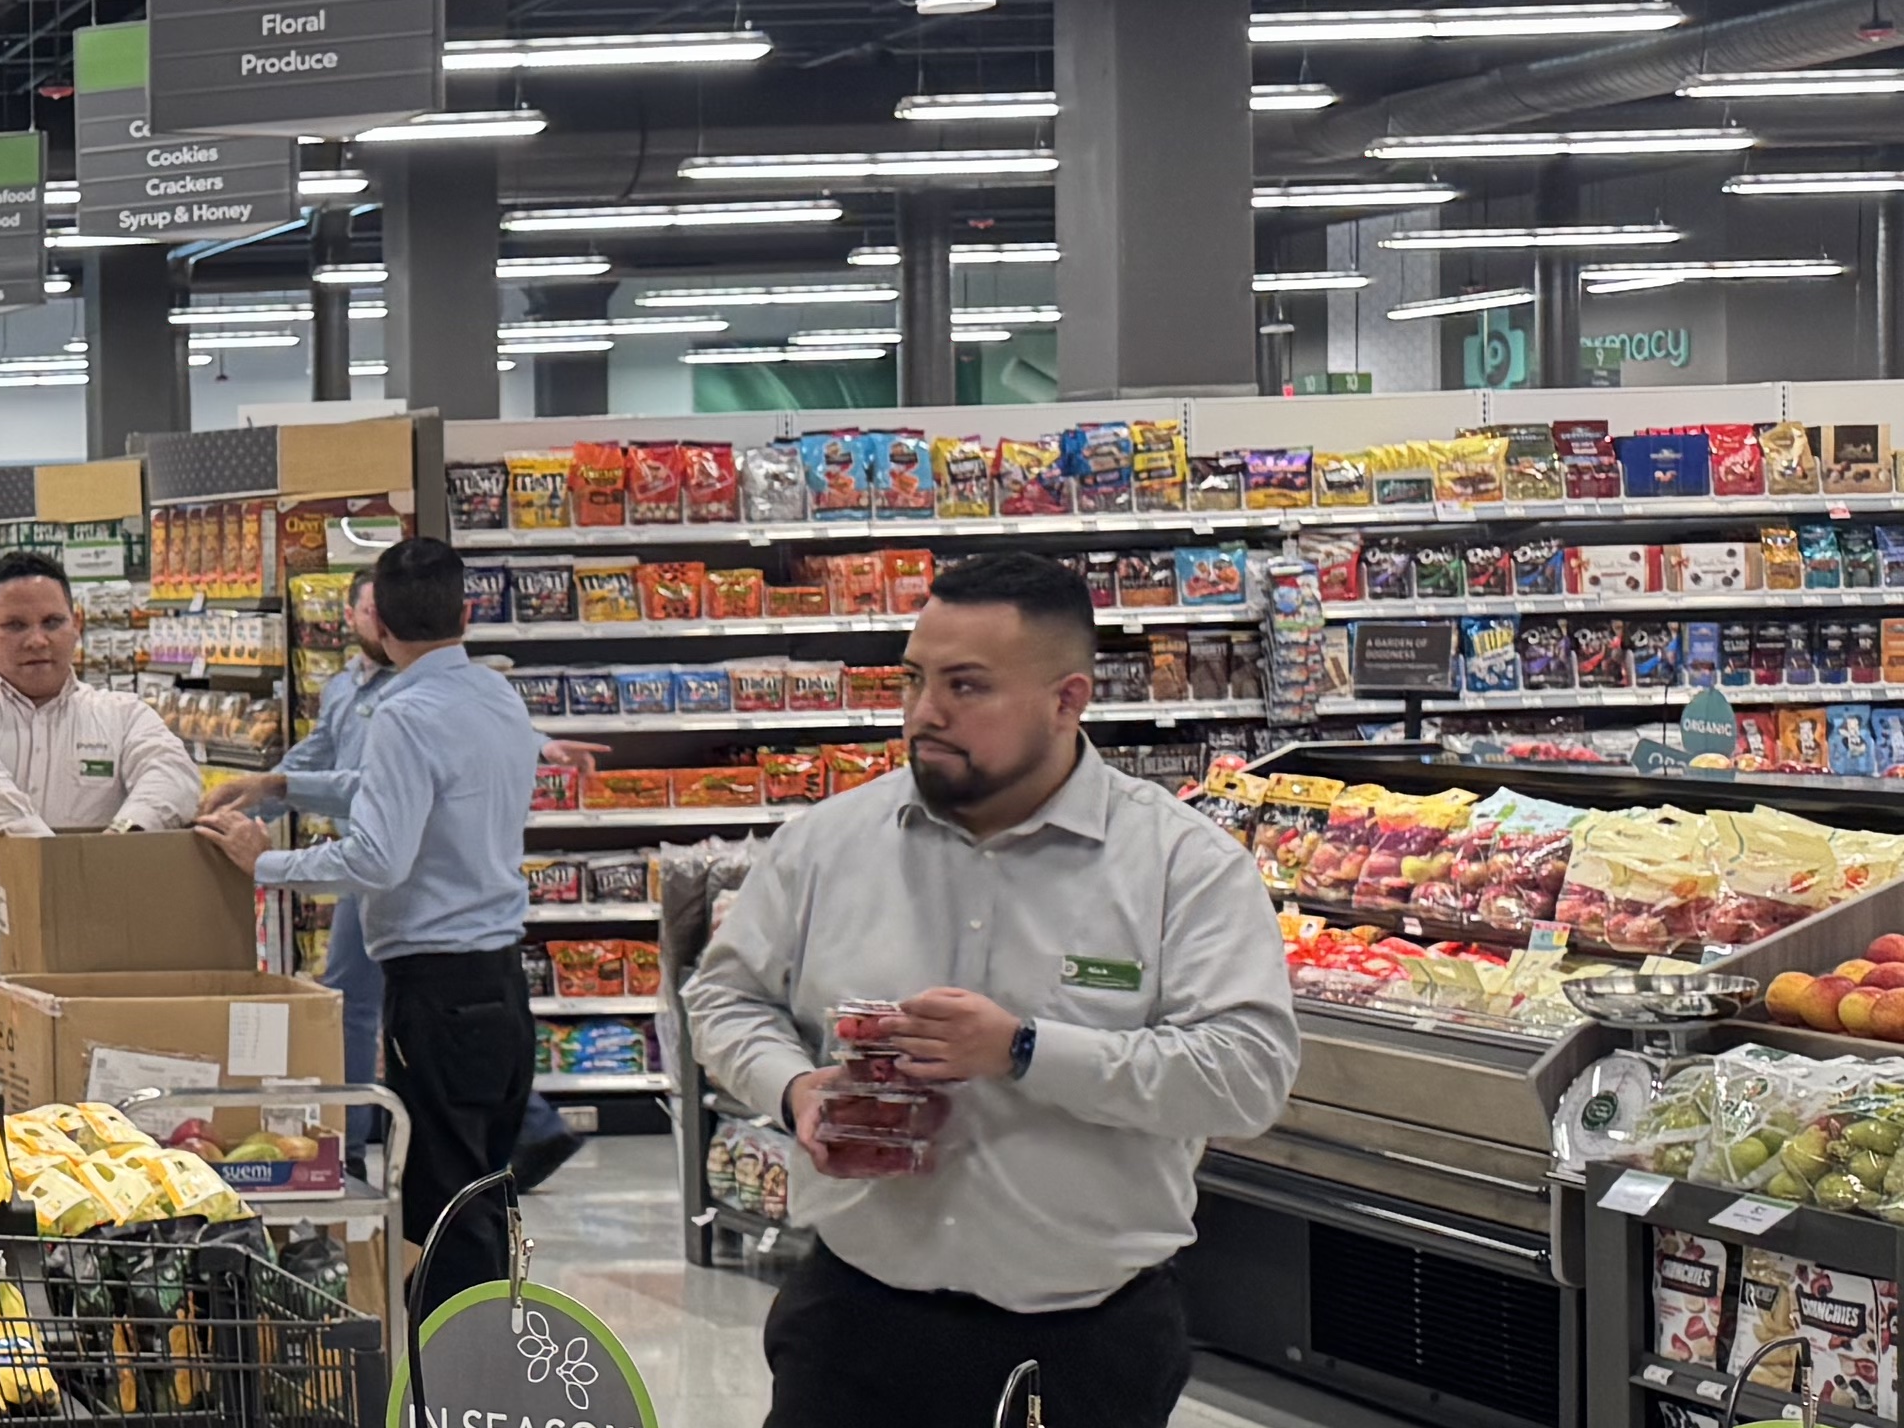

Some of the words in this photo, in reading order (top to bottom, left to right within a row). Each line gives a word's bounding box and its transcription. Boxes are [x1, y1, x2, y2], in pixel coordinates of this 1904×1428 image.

[261, 10, 326, 36] Floral
[240, 49, 338, 76] Produce
[146, 144, 219, 167] Cookies
[145, 176, 224, 196] Crackers
[119, 210, 171, 231] Syrup
[174, 205, 189, 223] &
[193, 203, 253, 222] Honey
[1375, 638, 1416, 649] GARDEN
[1419, 638, 1428, 649] OF
[1682, 719, 1733, 737] ORGANIC
[1801, 1296, 1860, 1330] CRUNCHIES
